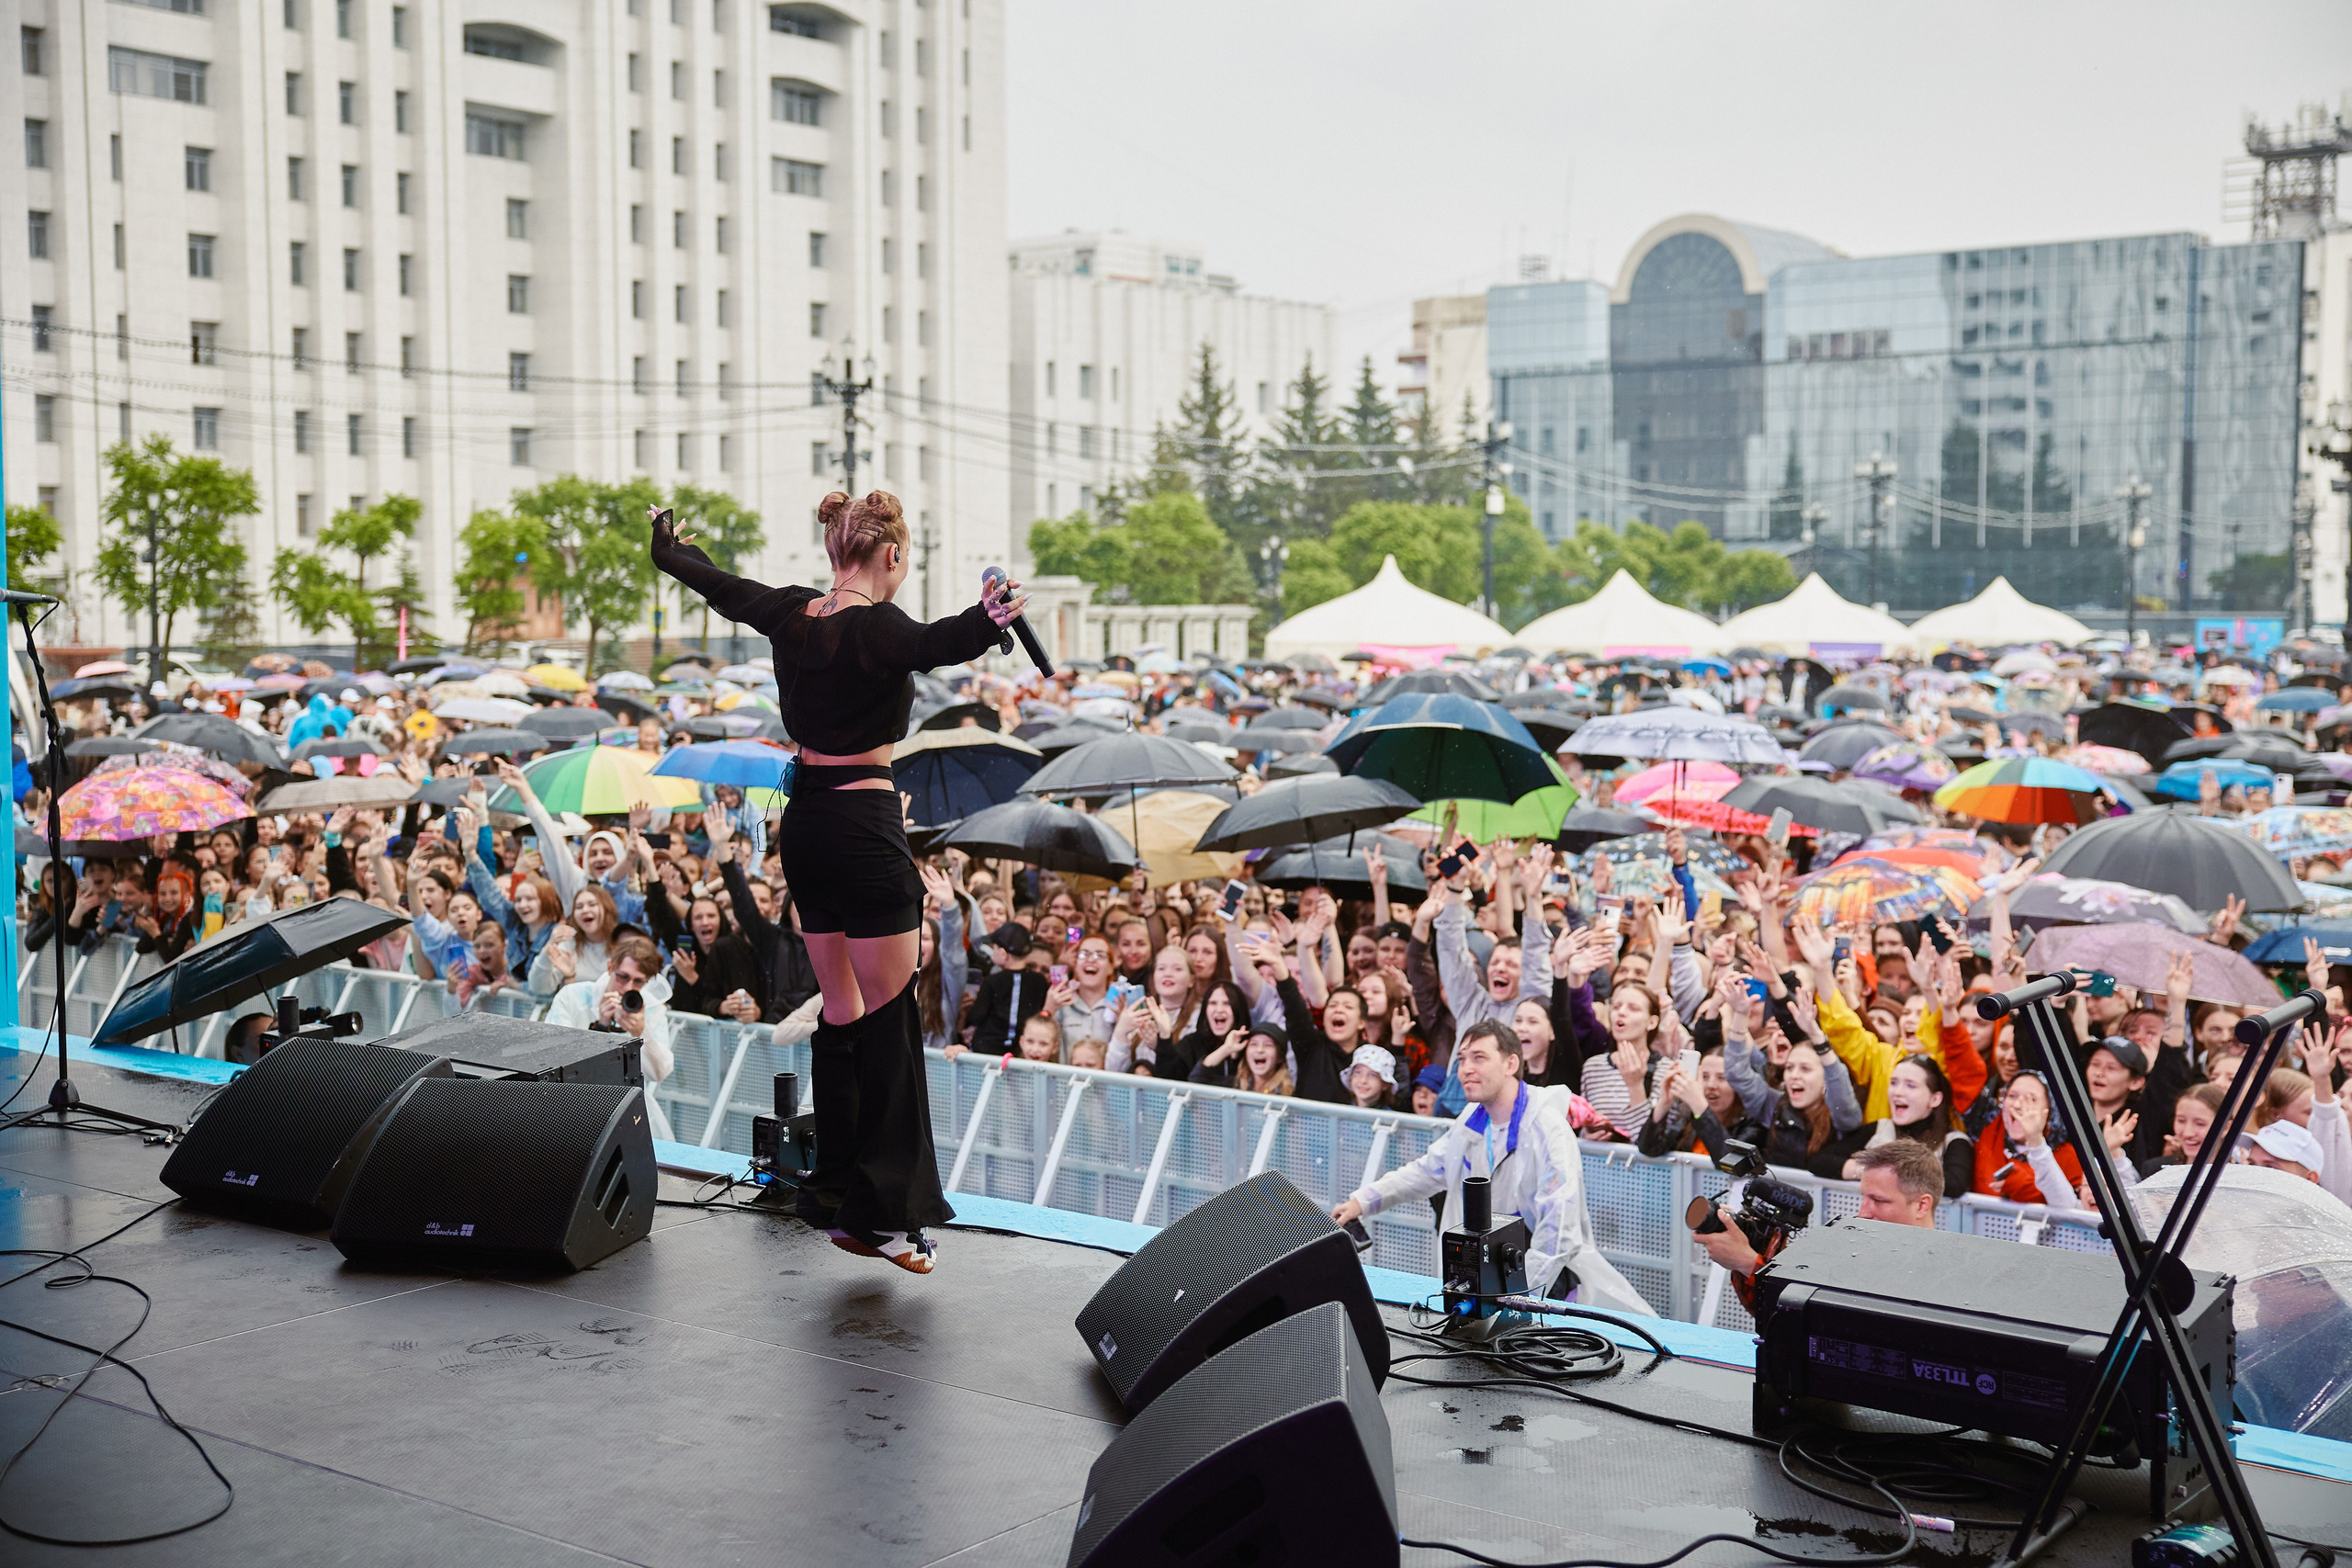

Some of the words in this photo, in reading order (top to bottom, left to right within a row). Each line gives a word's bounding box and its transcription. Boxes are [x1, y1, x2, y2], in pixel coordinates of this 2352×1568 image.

[424, 1228, 459, 1236] audiotechnik
[1912, 1362, 1970, 1387] TTL33A
[1978, 1379, 1995, 1391] RCF
